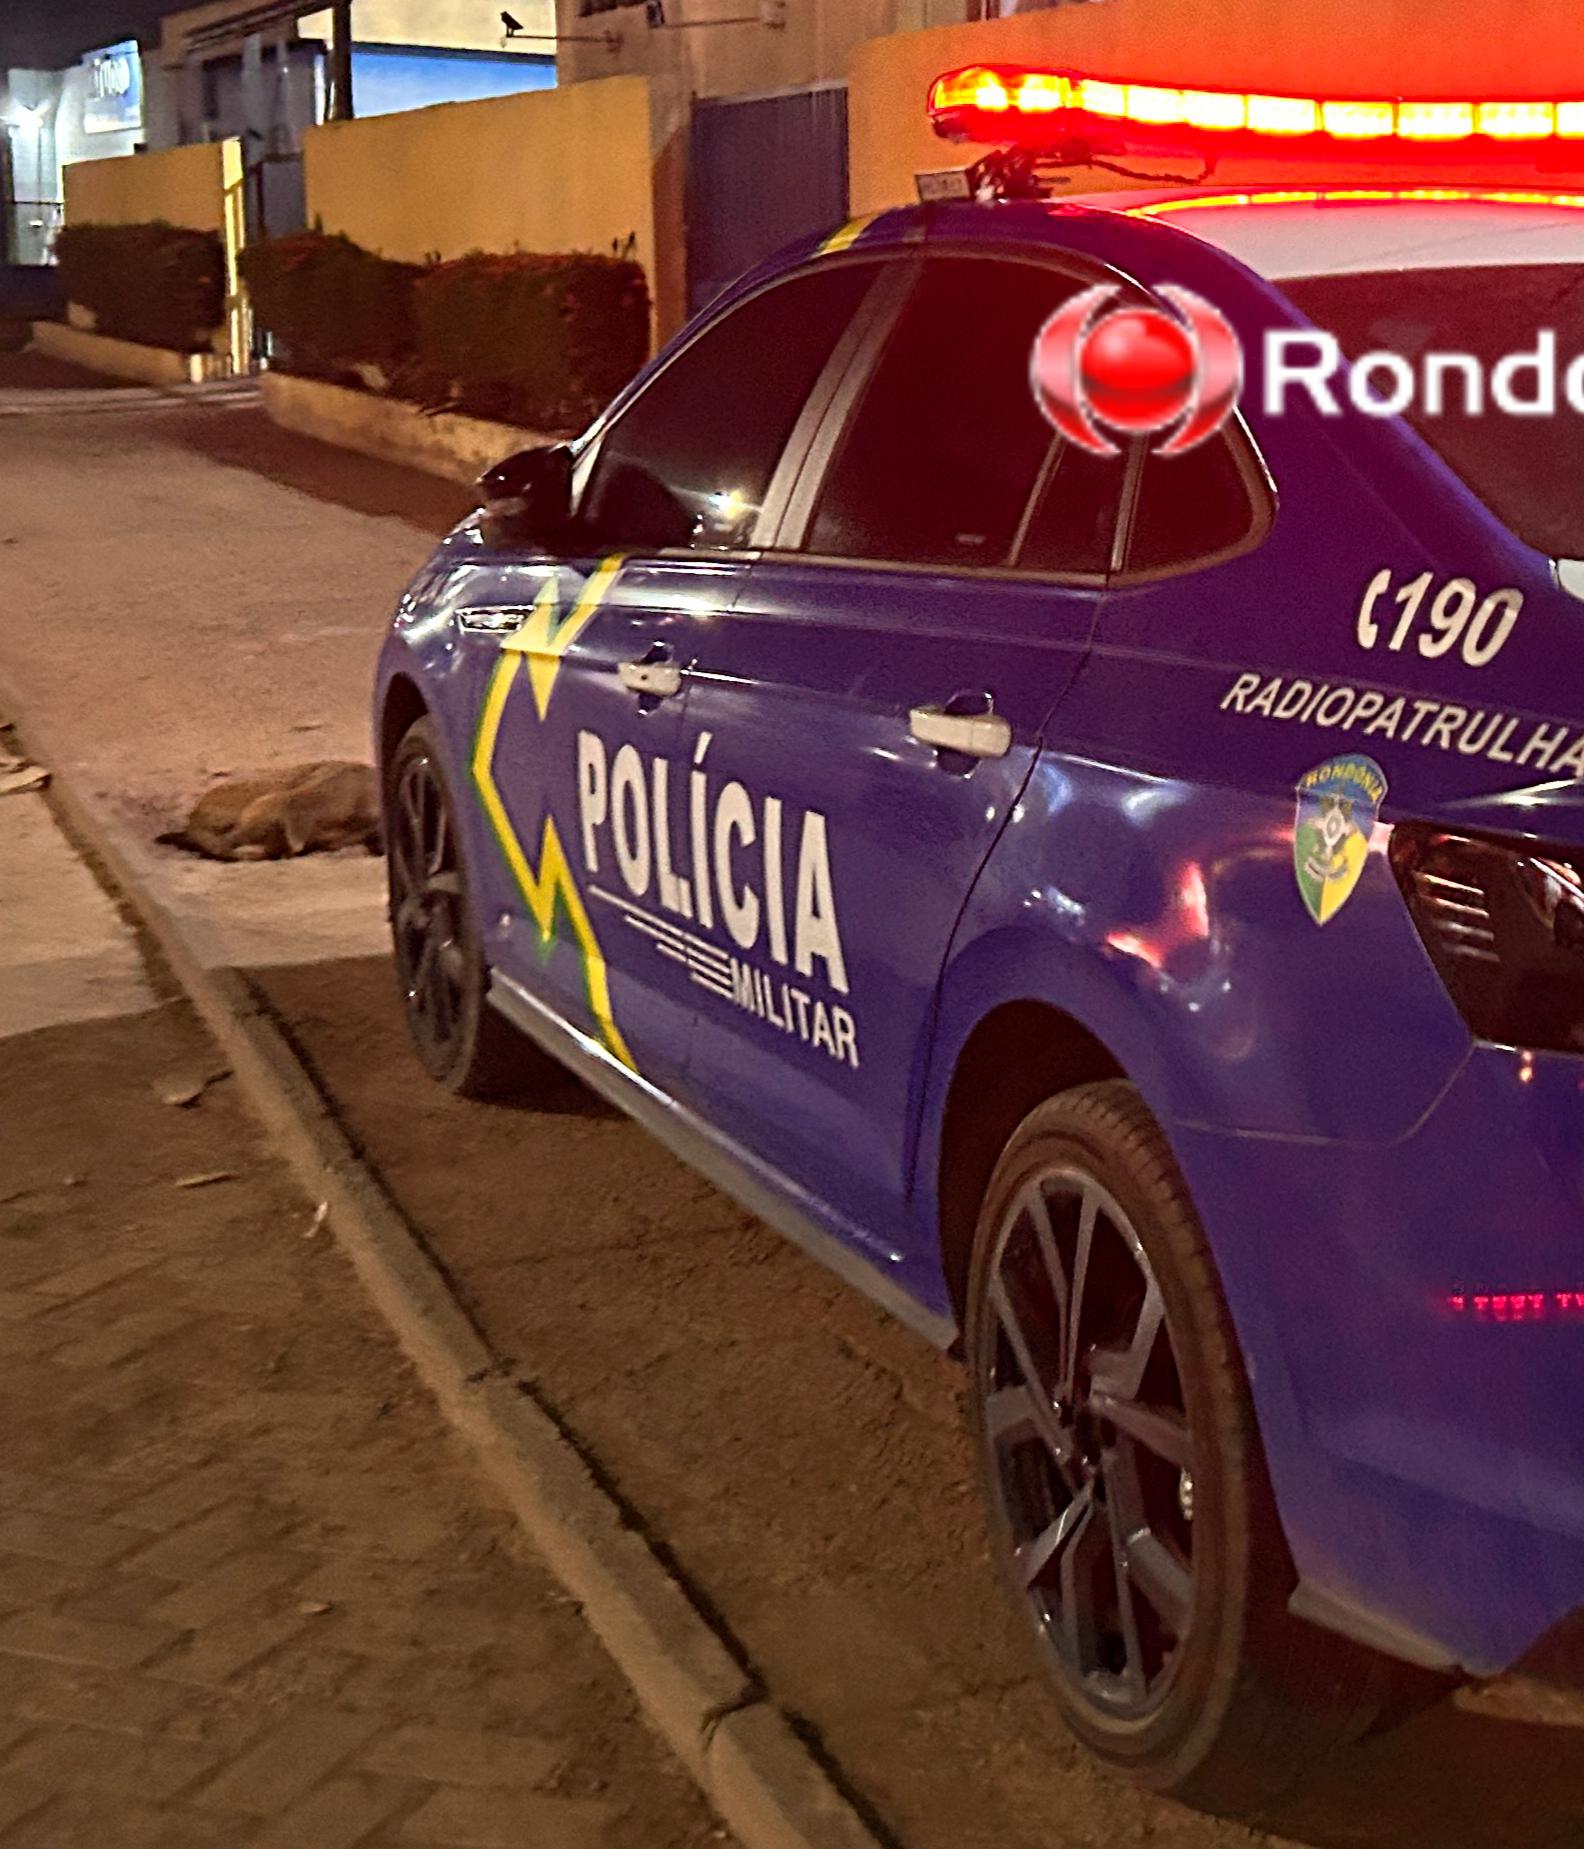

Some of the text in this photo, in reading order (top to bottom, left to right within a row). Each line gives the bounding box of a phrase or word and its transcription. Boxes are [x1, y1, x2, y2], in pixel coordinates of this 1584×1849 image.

[1388, 570, 1525, 667] 190
[577, 729, 850, 995] POLÍCIA
[729, 956, 860, 1070] MILITAR
